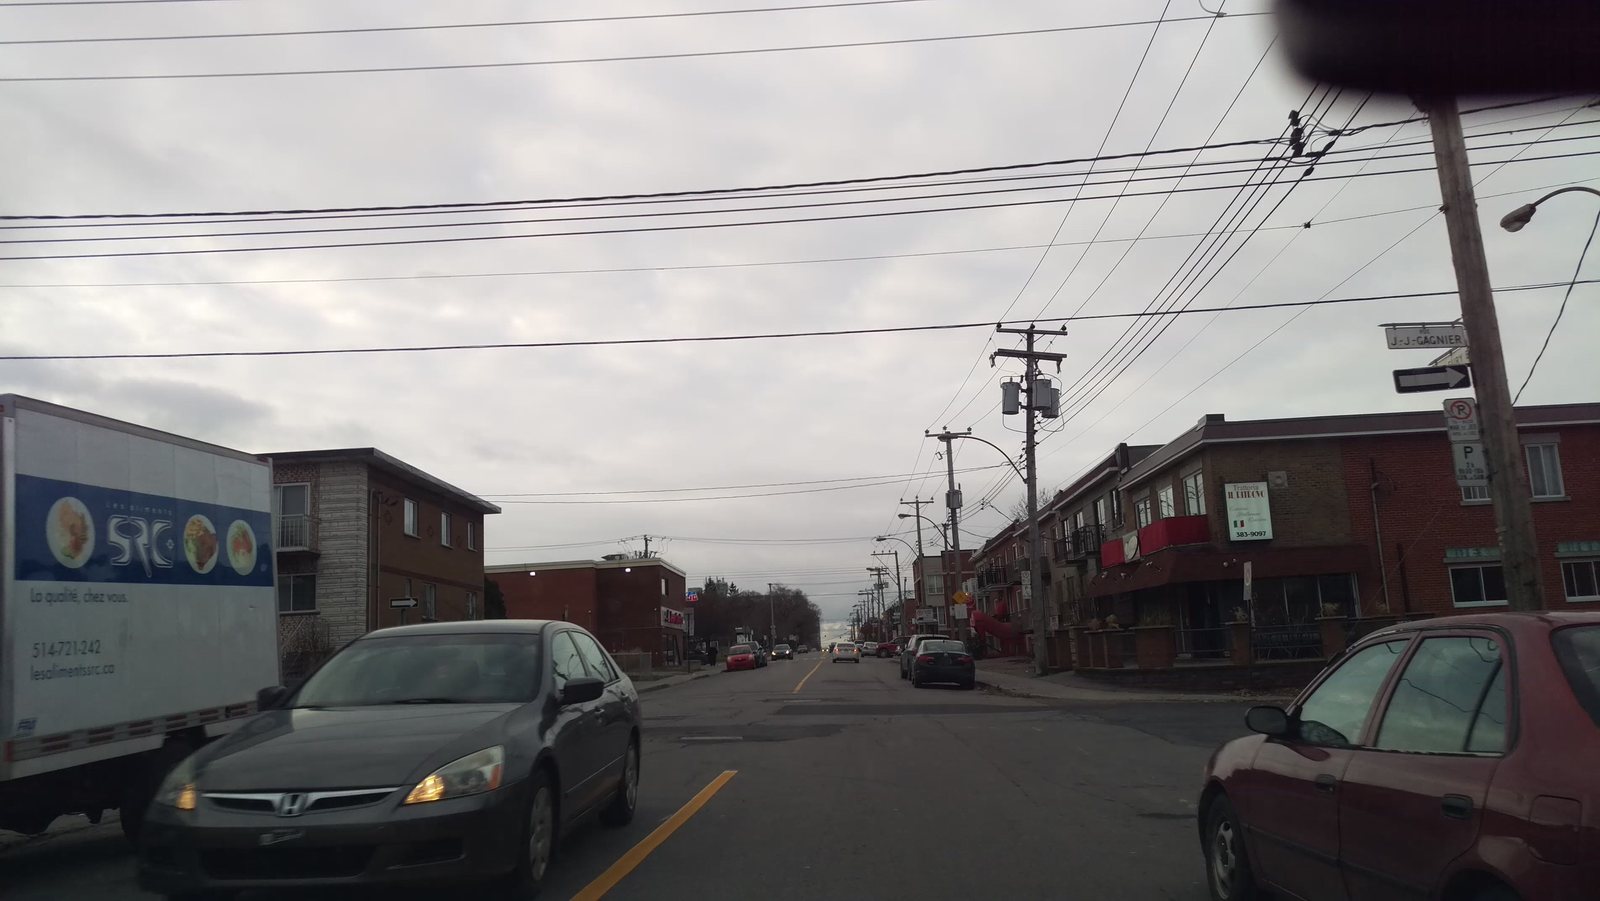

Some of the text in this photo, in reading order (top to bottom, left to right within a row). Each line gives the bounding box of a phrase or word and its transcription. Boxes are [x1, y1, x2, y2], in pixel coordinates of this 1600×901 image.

[1464, 446, 1473, 460] P
[106, 514, 174, 578] SRC
[83, 587, 104, 603] chez
